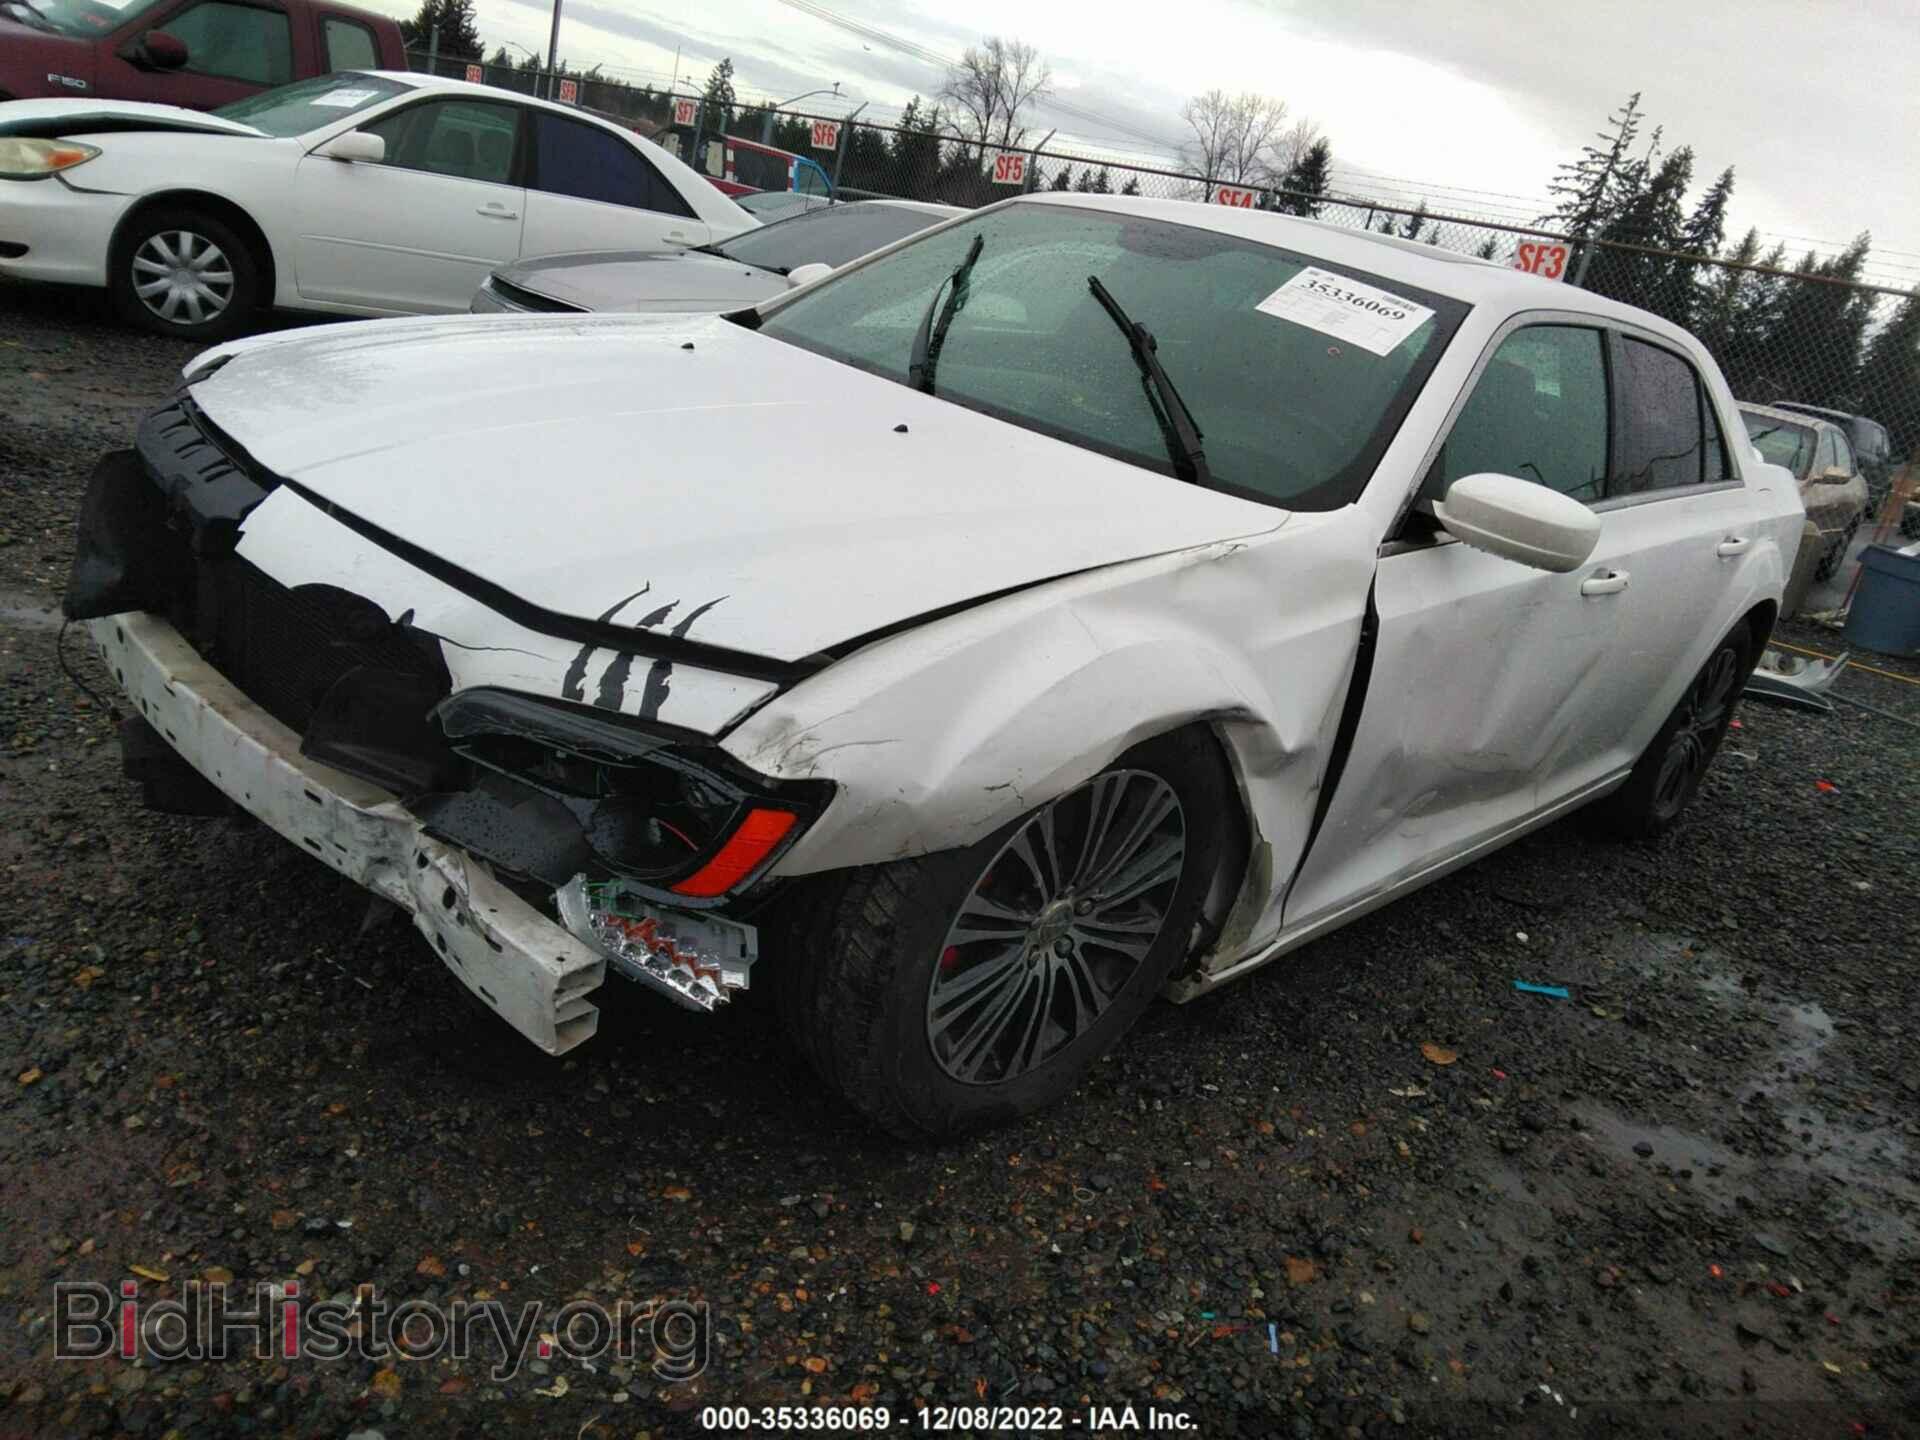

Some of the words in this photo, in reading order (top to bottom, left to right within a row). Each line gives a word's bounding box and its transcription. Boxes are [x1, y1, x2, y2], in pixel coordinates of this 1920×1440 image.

[677, 101, 695, 123] SF7
[813, 122, 836, 148] SF6
[995, 155, 1024, 181] SF5
[1515, 243, 1566, 278] SF3
[1301, 279, 1406, 321] 35336069
